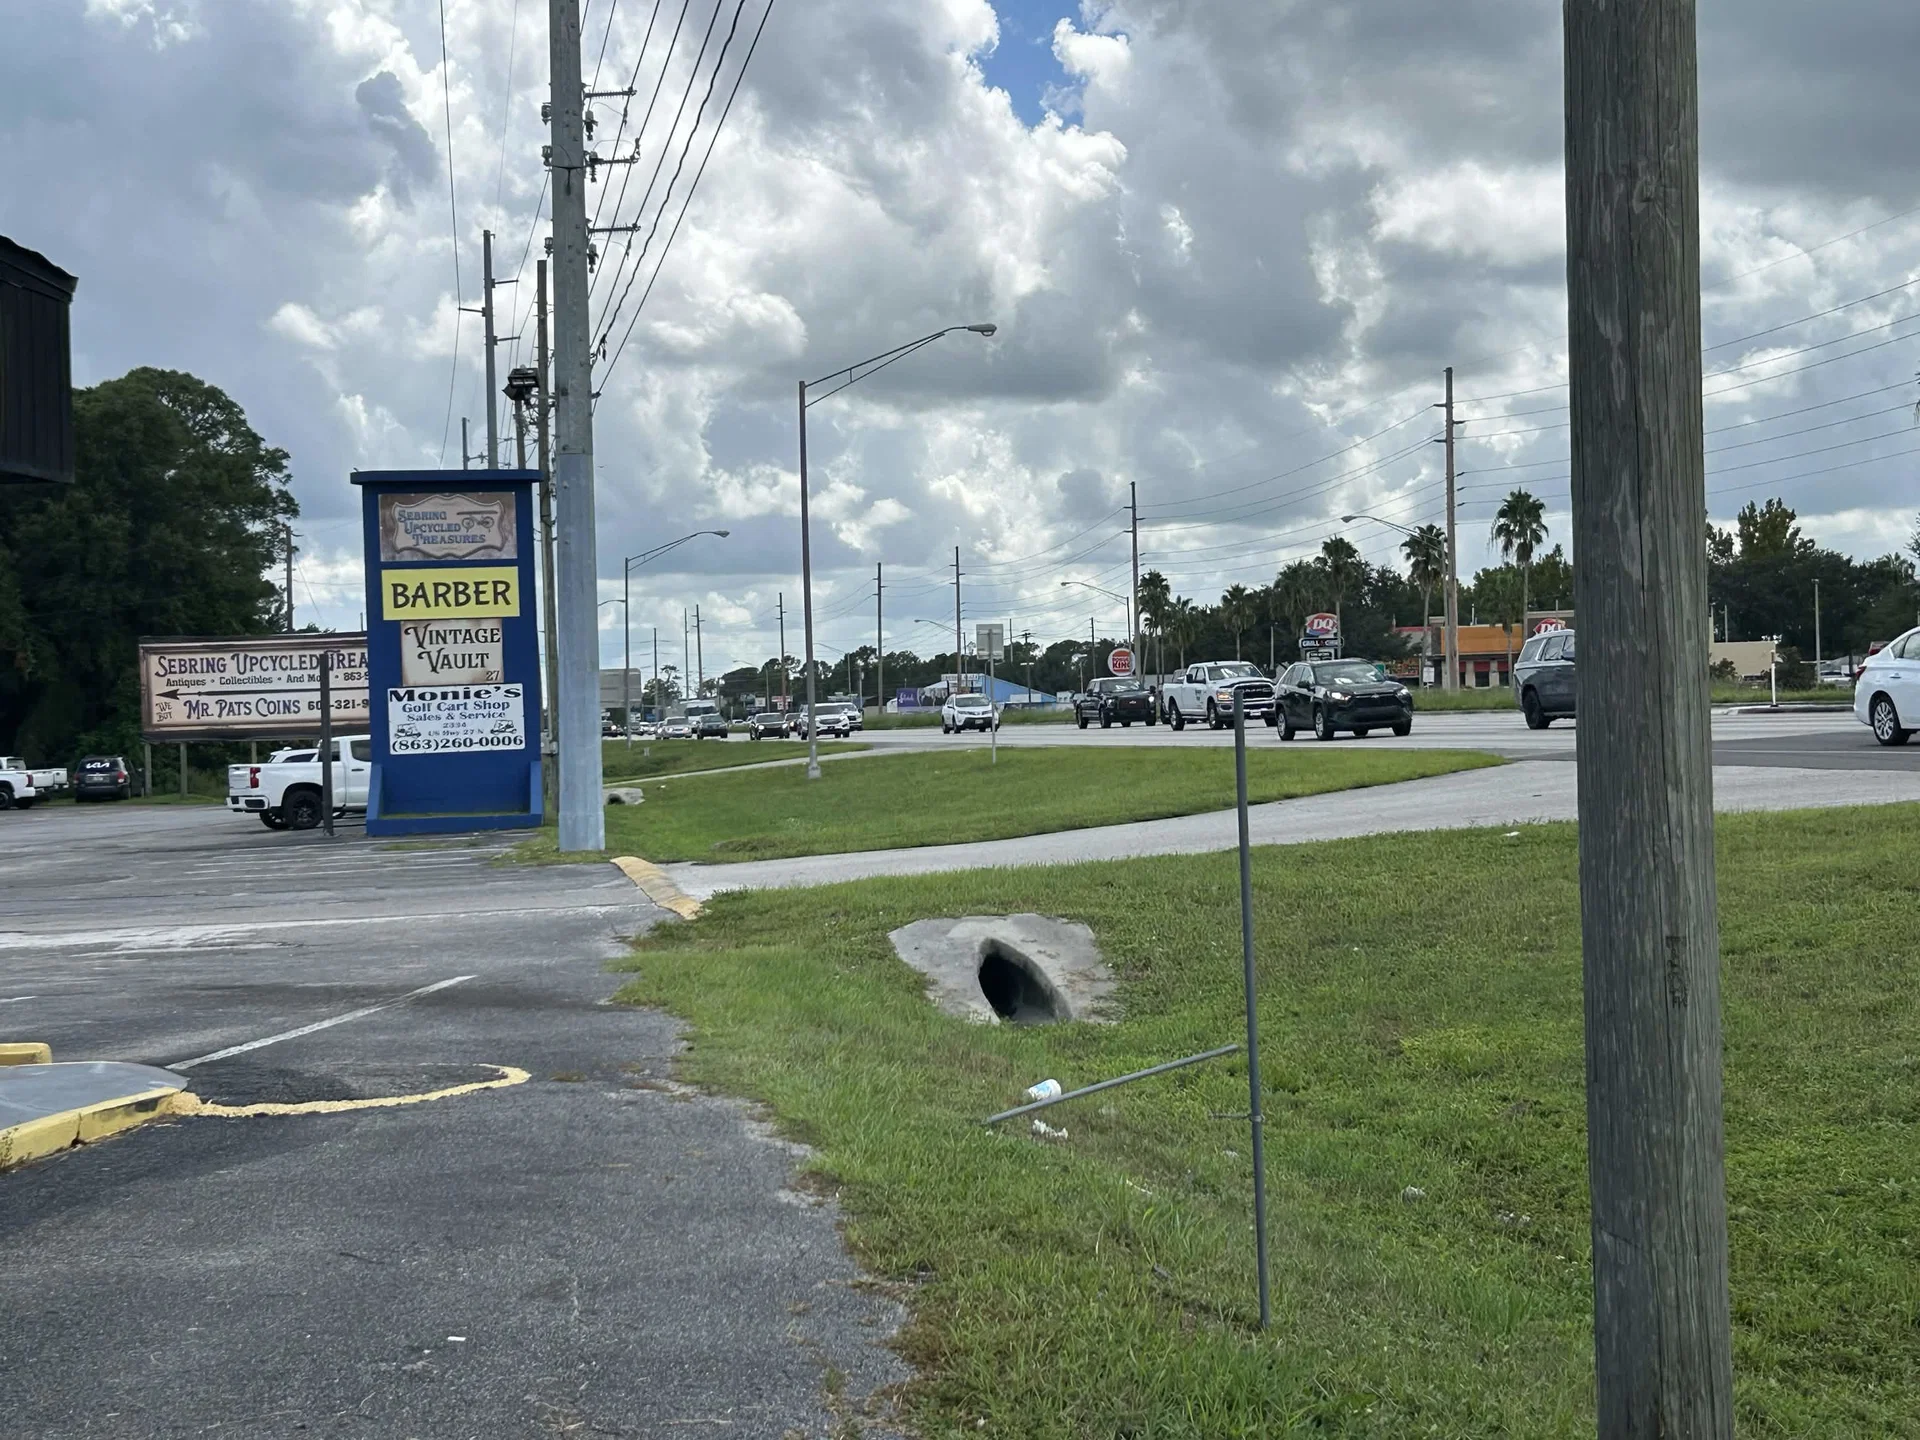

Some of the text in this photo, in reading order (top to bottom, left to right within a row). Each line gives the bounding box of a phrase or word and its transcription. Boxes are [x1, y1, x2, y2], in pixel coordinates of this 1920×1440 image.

[397, 509, 447, 522] SEBRING
[404, 521, 461, 534] UPCYCLED
[412, 533, 486, 547] TREASURES
[391, 580, 512, 609] BARBER
[1312, 618, 1335, 630] DQ
[404, 623, 501, 650] VINTAGE
[155, 655, 227, 677] SEBRING
[230, 652, 320, 675] UPCYCLED
[417, 647, 490, 674] VAULT
[166, 678, 206, 688] Antiques
[219, 675, 273, 686] Collectibles
[286, 673, 305, 683] And
[486, 670, 500, 682] 27
[389, 686, 521, 702] Monie's
[155, 702, 172, 712] WE
[215, 698, 252, 718] PATS
[255, 697, 301, 717] COINS
[402, 700, 510, 713] Golf Cart Shop
[407, 711, 506, 722] Sales & Service
[392, 735, 524, 752] (863)260-0006
